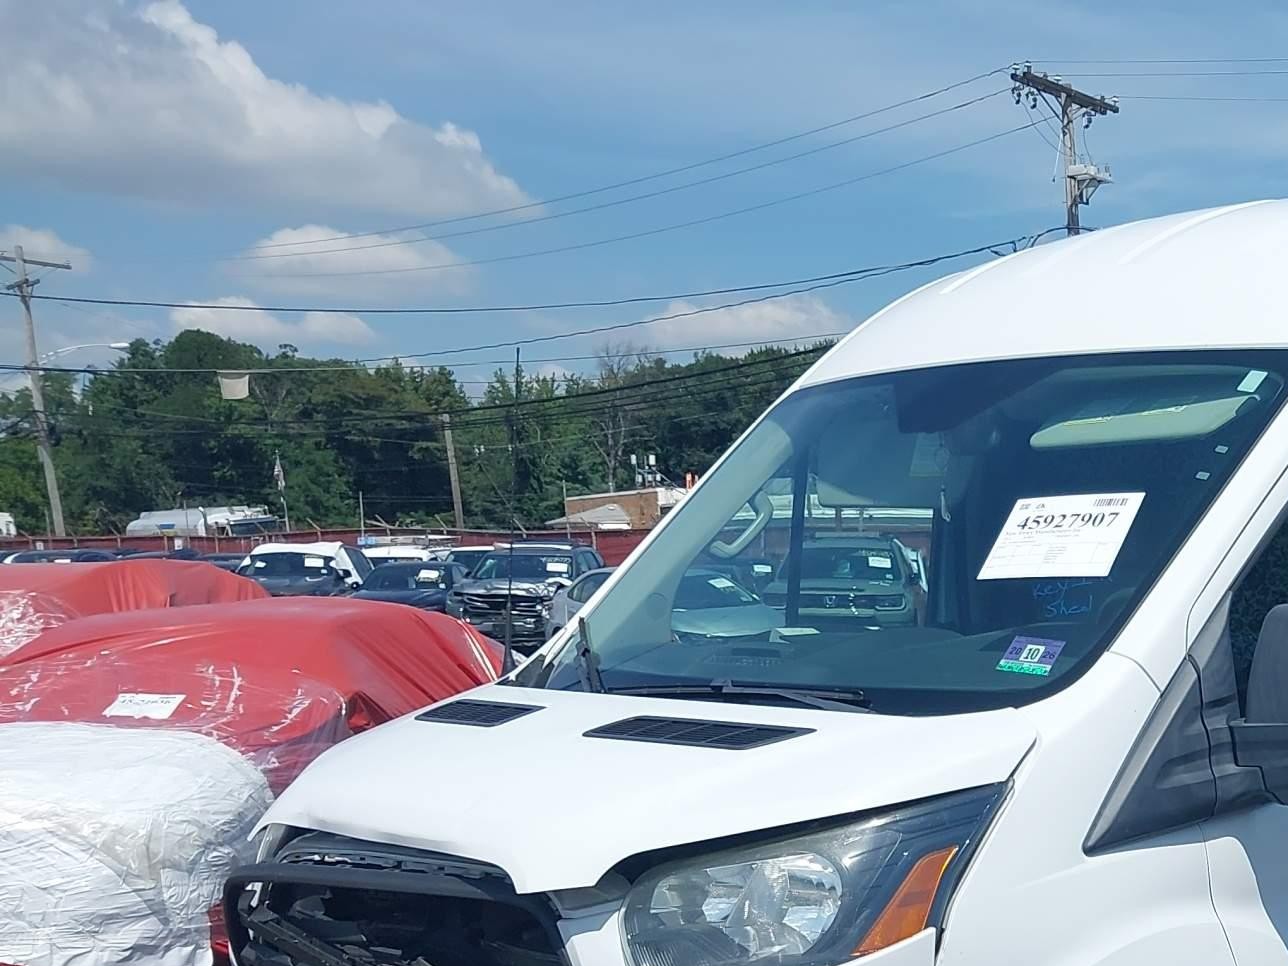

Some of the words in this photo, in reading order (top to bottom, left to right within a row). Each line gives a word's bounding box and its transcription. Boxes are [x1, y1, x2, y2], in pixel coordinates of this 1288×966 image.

[1016, 512, 1120, 530] 45927907
[1009, 646, 1023, 656] 20
[1023, 647, 1041, 661] 10
